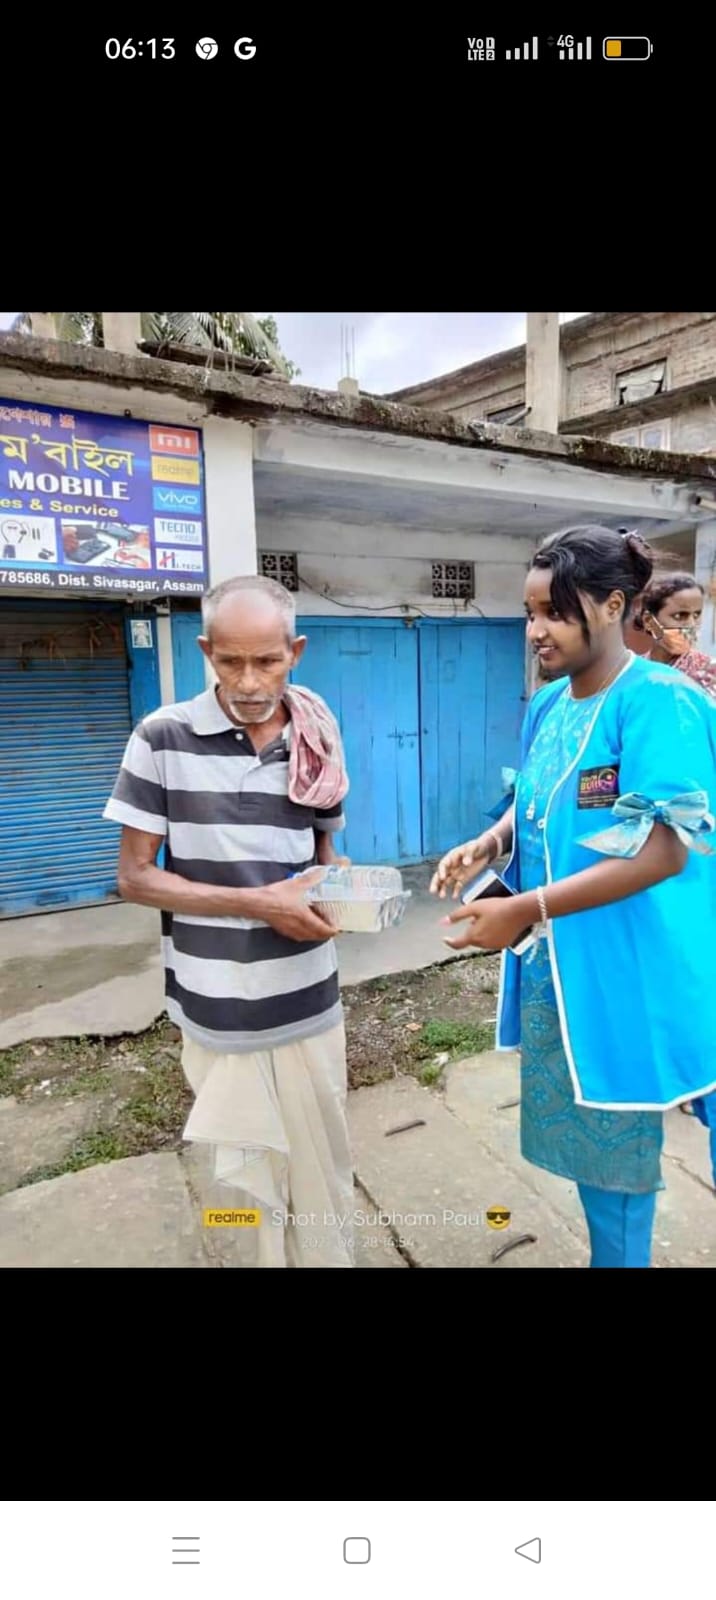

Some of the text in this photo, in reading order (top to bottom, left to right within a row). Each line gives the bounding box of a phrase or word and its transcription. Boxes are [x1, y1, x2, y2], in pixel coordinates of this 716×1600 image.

[8, 469, 130, 501] MOBILE
[29, 498, 43, 511] &
[49, 500, 119, 518] Service
[0, 570, 204, 592] 785686, Dist. Sivasagar, Assam
